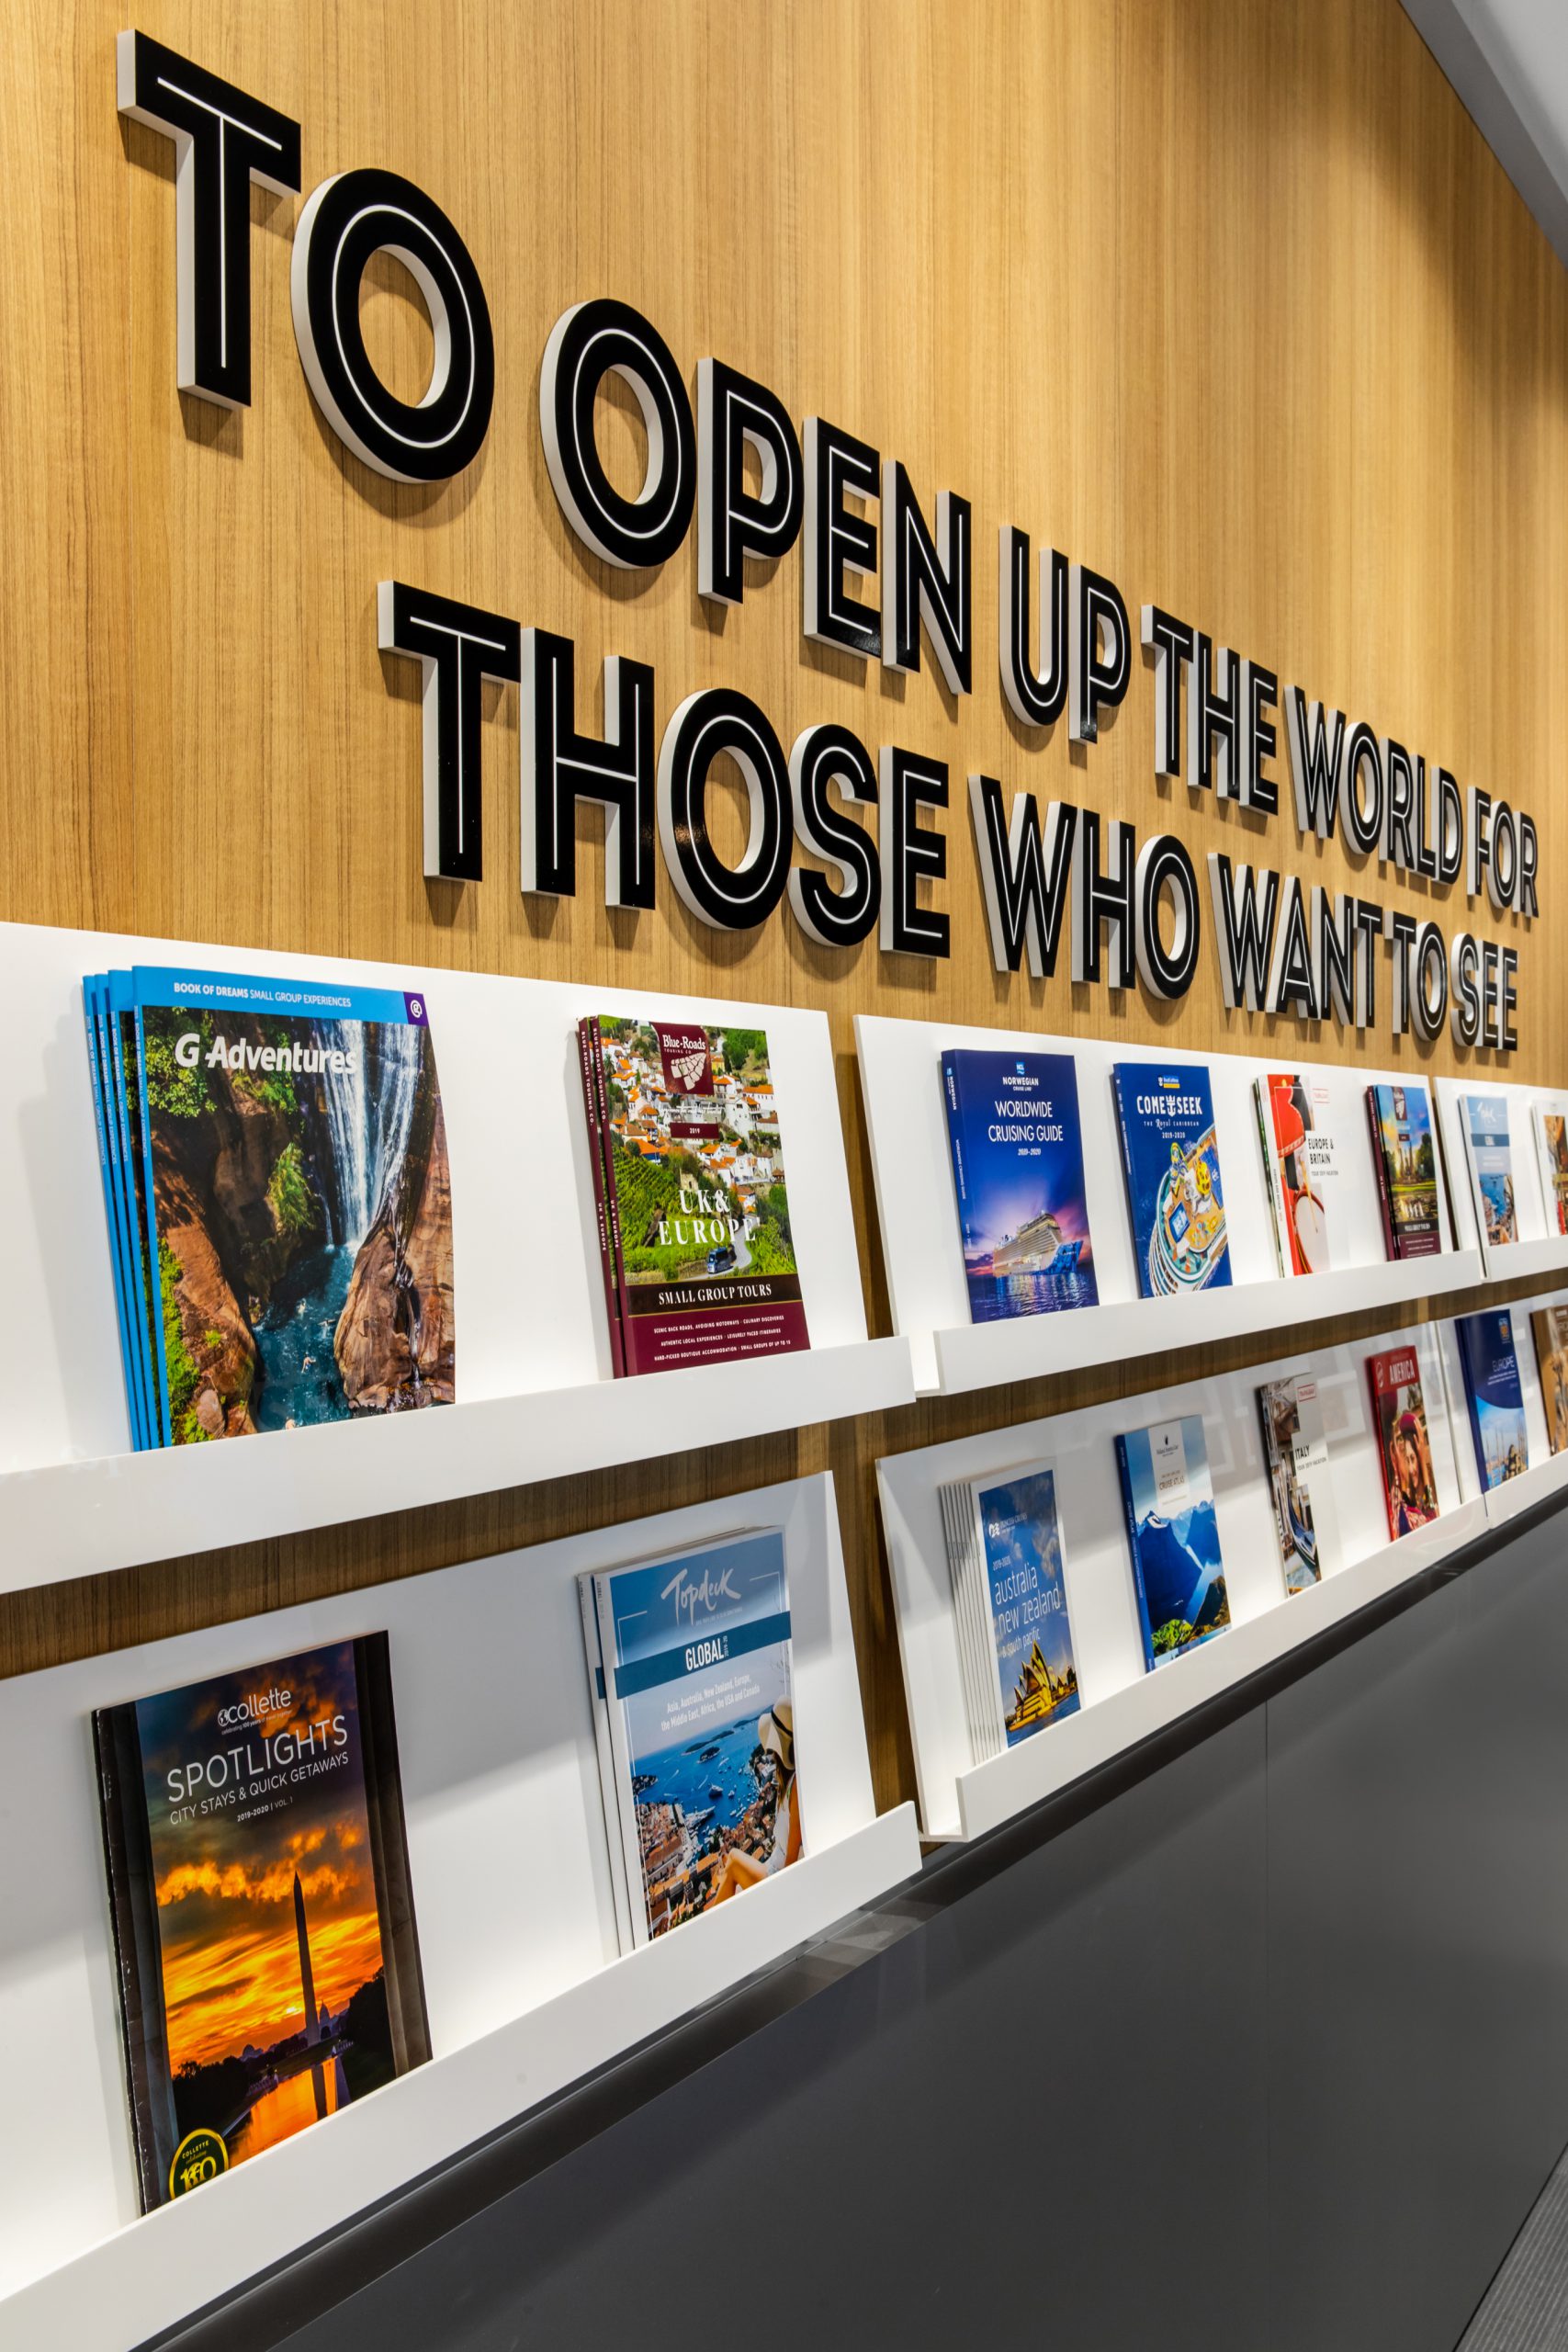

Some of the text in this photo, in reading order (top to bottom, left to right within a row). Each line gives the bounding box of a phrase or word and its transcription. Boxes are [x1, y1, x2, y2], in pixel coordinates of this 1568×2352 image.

[117, 28, 1539, 918] TO OPEN UP THE WORLD FOR
[378, 581, 1517, 1051] THOSE WHO WANT TO SEE
[174, 982, 351, 1007] BOOK OF DREAMS SMALL GROUP EXPERIENCES
[175, 1033, 357, 1075] G Adventures
[662, 1035, 705, 1049] Blue-Roads
[1003, 1077, 1039, 1086] NORWEGIAN
[995, 1101, 1053, 1117] WORLDWIDE
[1137, 1096, 1166, 1114] COME
[1177, 1097, 1202, 1114] SEEK
[988, 1125, 1064, 1142] CRUISING GUIDE
[1308, 1138, 1328, 1149] EUROPE
[1310, 1154, 1330, 1164] BRITAIN
[659, 1216, 760, 1245] EUROPE
[659, 1283, 772, 1305] SMALL GROUP TOURS
[702, 1347, 737, 1355] ACCOMMODATION
[1390, 1360, 1416, 1385] AMERICA
[1295, 1445, 1310, 1460] ITALY
[995, 1563, 1038, 1606] australia
[661, 1568, 741, 1627] Topdeck
[998, 1581, 1060, 1635] new zealand
[685, 1638, 724, 1671] GLOBAL
[228, 1688, 291, 1724] collette
[661, 1720, 671, 1731] the
[671, 1715, 687, 1728] Middle
[725, 1695, 734, 1706] USA
[735, 1691, 743, 1702] and
[744, 1683, 760, 1699] Canada
[682, 1693, 704, 1708] Australia,
[704, 1688, 714, 1698] New
[167, 1715, 347, 1803] SPOTLIGHTS
[170, 1751, 348, 1825] CITY STAYS & QUICK GETAWAYS
[237, 1804, 269, 1822] 2019-2020
[275, 1798, 288, 1809] VOL.
[182, 2140, 209, 2159] COLLETTE
